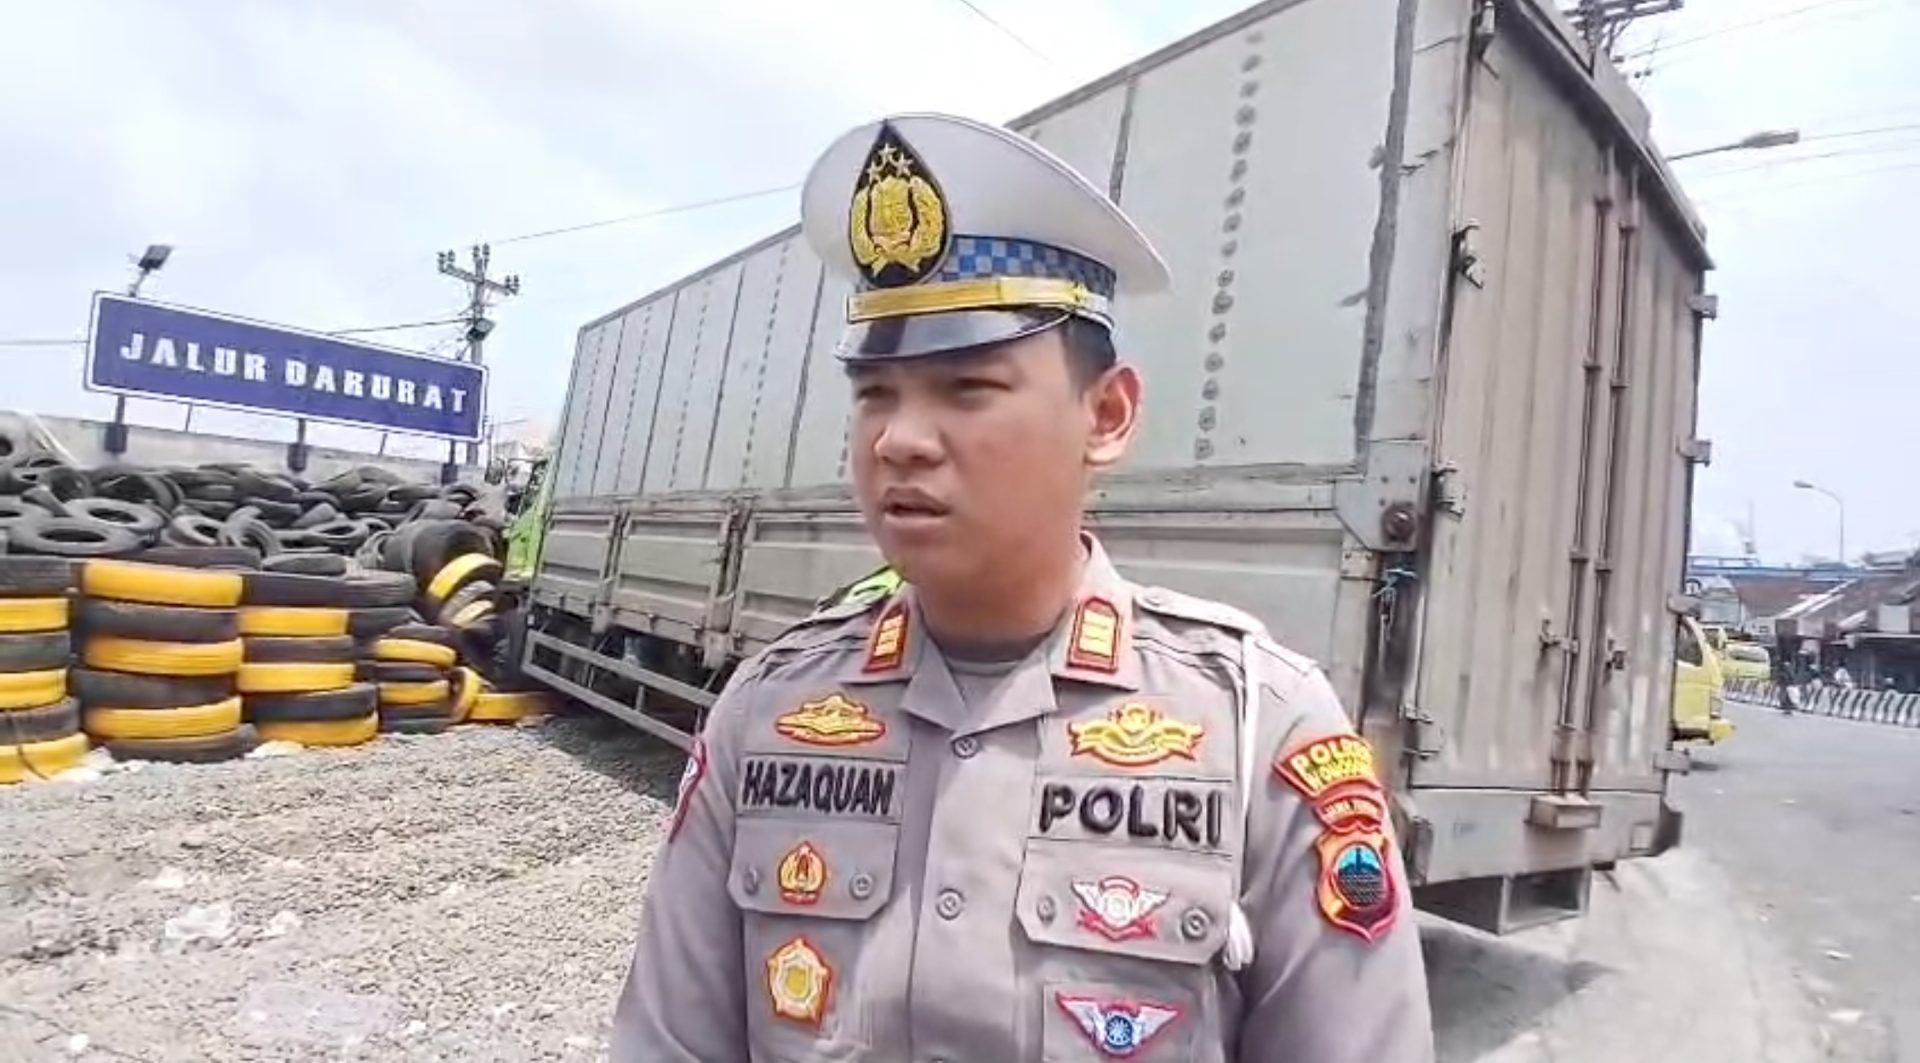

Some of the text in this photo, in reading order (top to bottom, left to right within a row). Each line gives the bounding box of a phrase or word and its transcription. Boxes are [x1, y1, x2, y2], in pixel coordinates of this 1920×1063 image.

[120, 333, 468, 412] JALUR DARURAT
[742, 759, 895, 816] HAZAQUAN
[1039, 783, 1222, 848] POLRI
